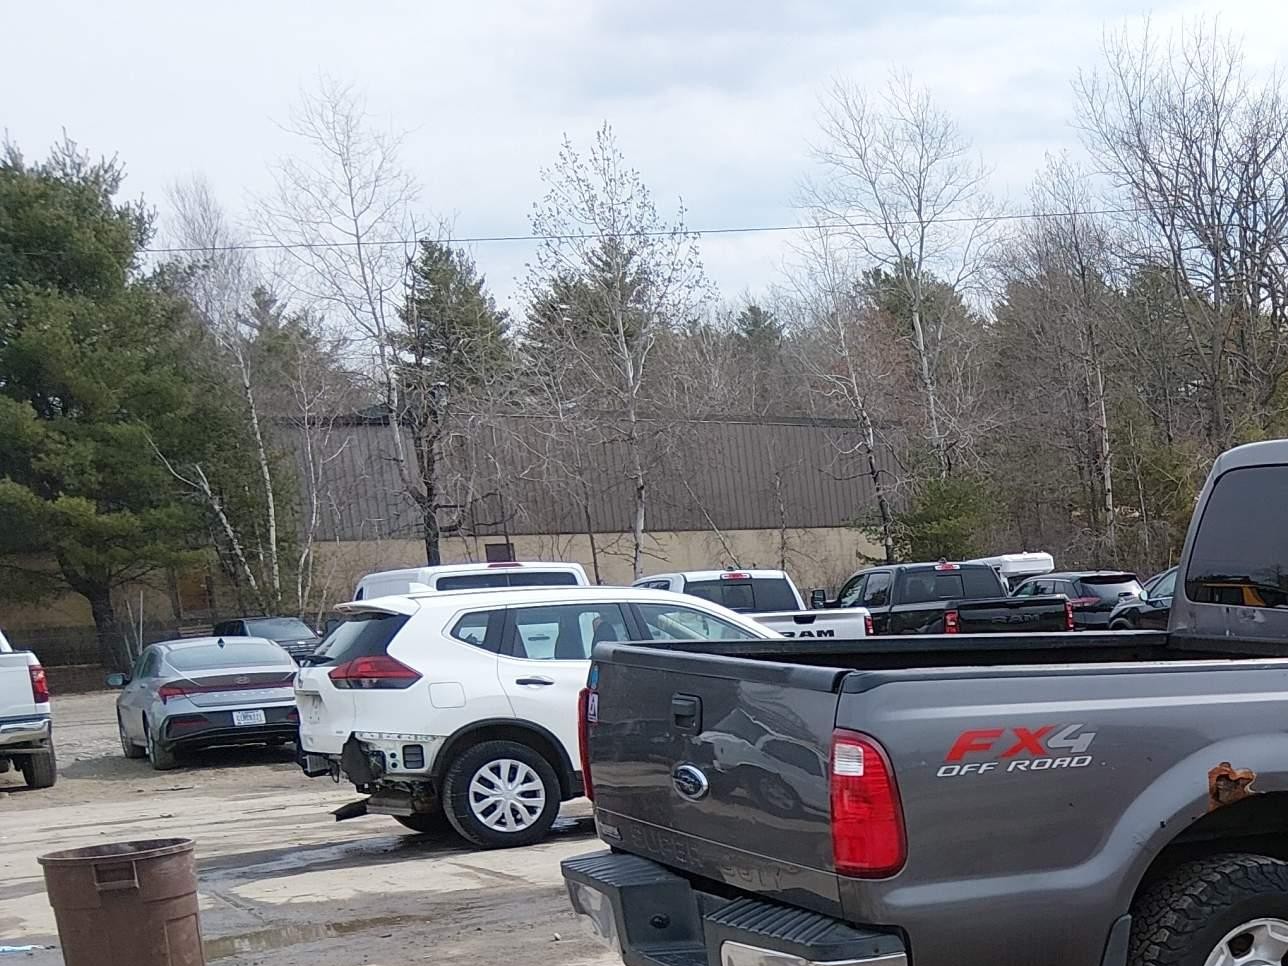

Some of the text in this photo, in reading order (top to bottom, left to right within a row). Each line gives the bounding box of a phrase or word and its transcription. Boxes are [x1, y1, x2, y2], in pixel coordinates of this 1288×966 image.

[944, 723, 1097, 763] FX4
[936, 755, 1093, 778] OFF ROAD
